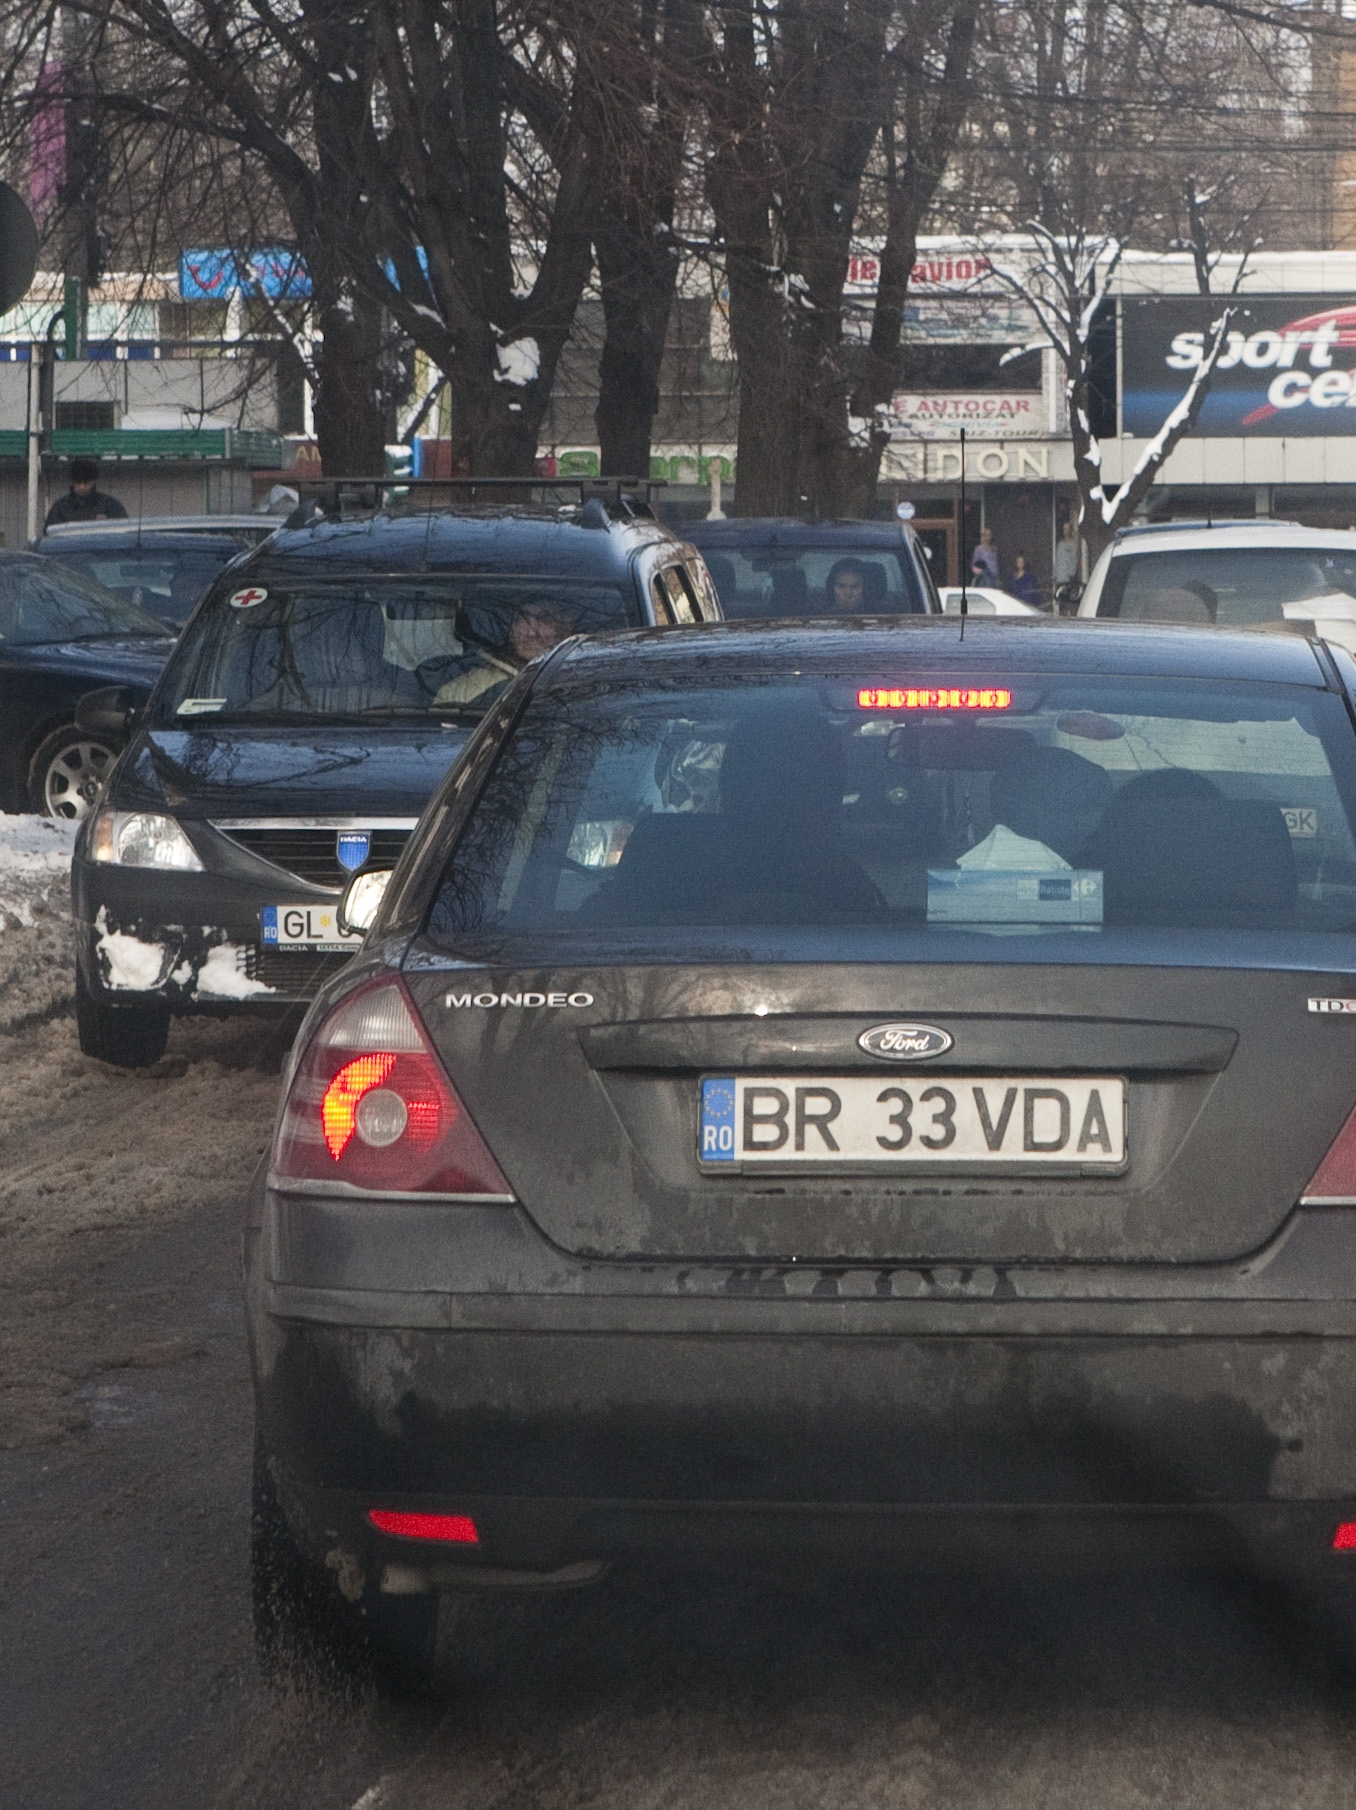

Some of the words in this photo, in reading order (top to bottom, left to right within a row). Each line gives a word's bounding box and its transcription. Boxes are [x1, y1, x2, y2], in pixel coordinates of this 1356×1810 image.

[917, 399, 1031, 413] AUTOCAR
[263, 924, 278, 939] RO
[283, 910, 324, 939] GL
[279, 944, 309, 952] DACIA
[445, 992, 595, 1008] MONDEO
[879, 1030, 930, 1051] Ford
[742, 1086, 842, 1152] BR
[875, 1086, 957, 1151] 33
[972, 1086, 1112, 1153] VDA
[703, 1125, 733, 1151] RO
